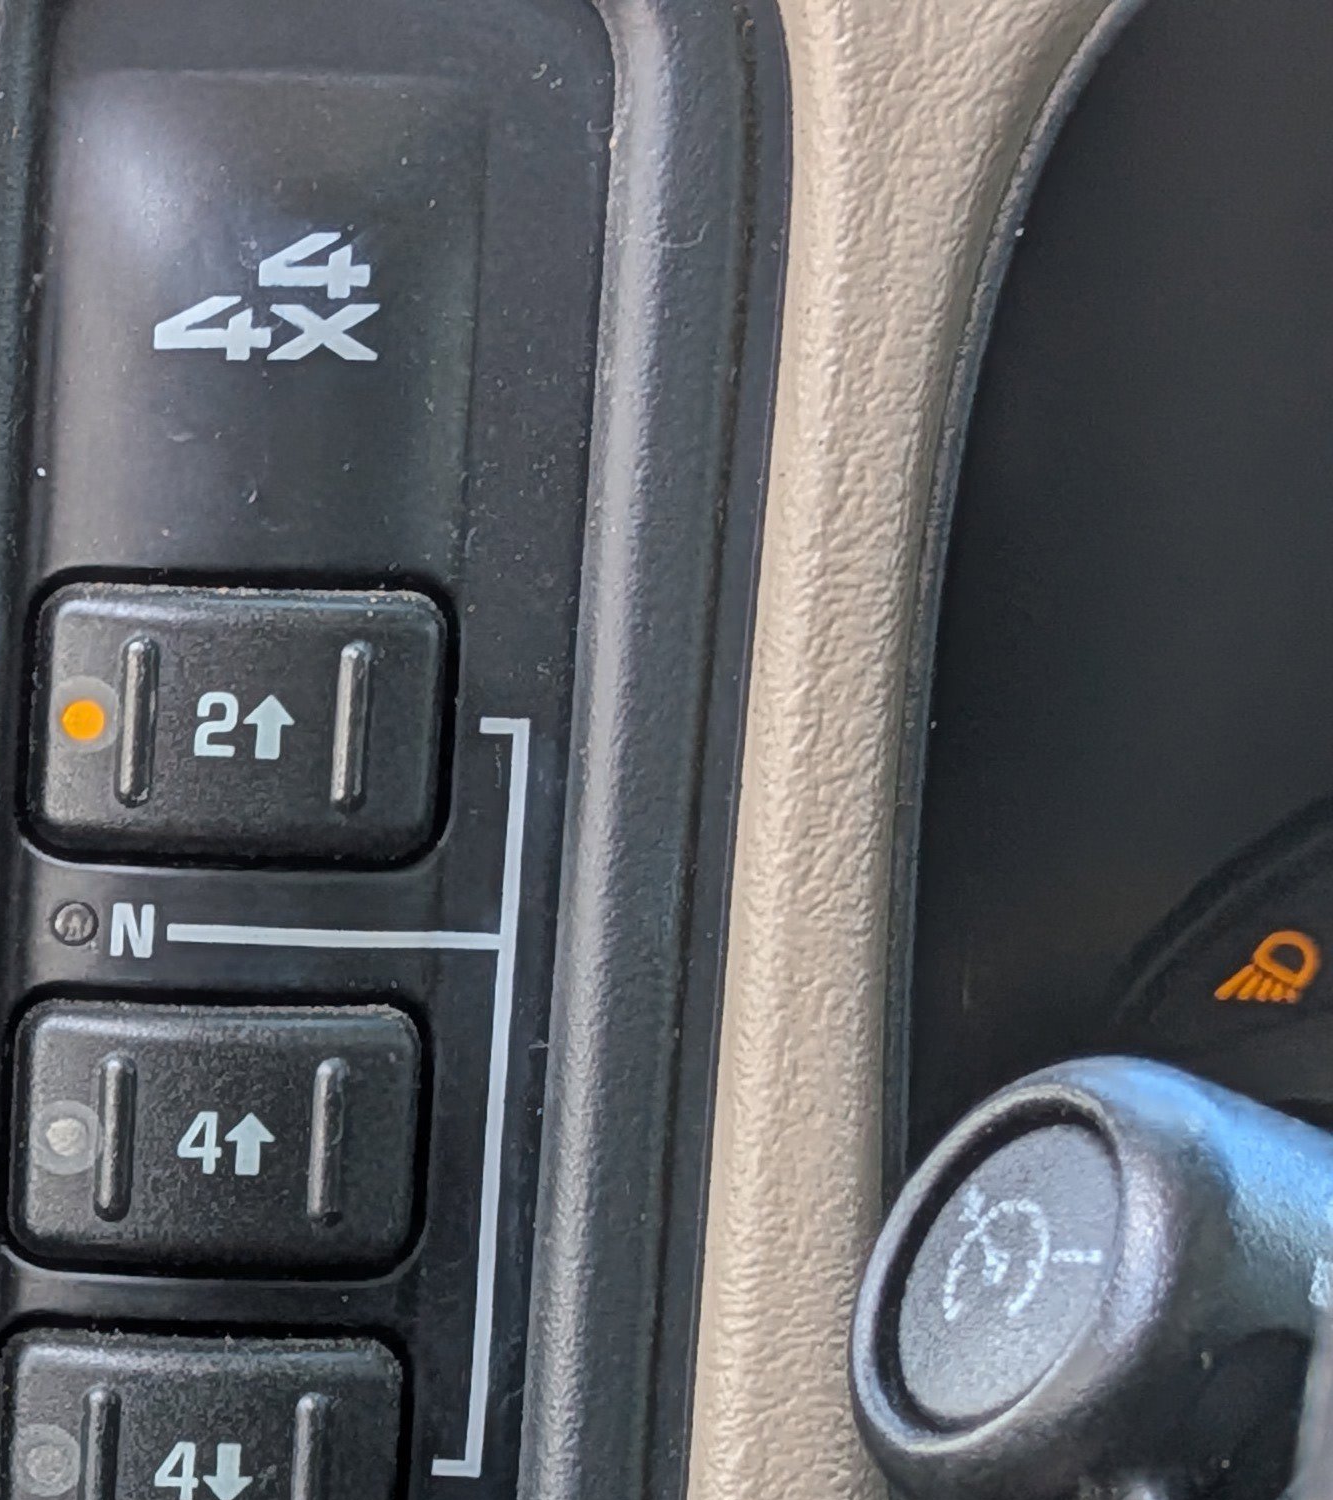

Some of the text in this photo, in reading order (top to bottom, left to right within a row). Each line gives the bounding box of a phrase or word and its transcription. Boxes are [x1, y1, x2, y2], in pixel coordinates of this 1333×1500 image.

[193, 691, 239, 758] 2
[109, 902, 155, 959] N
[176, 1111, 222, 1175] 4
